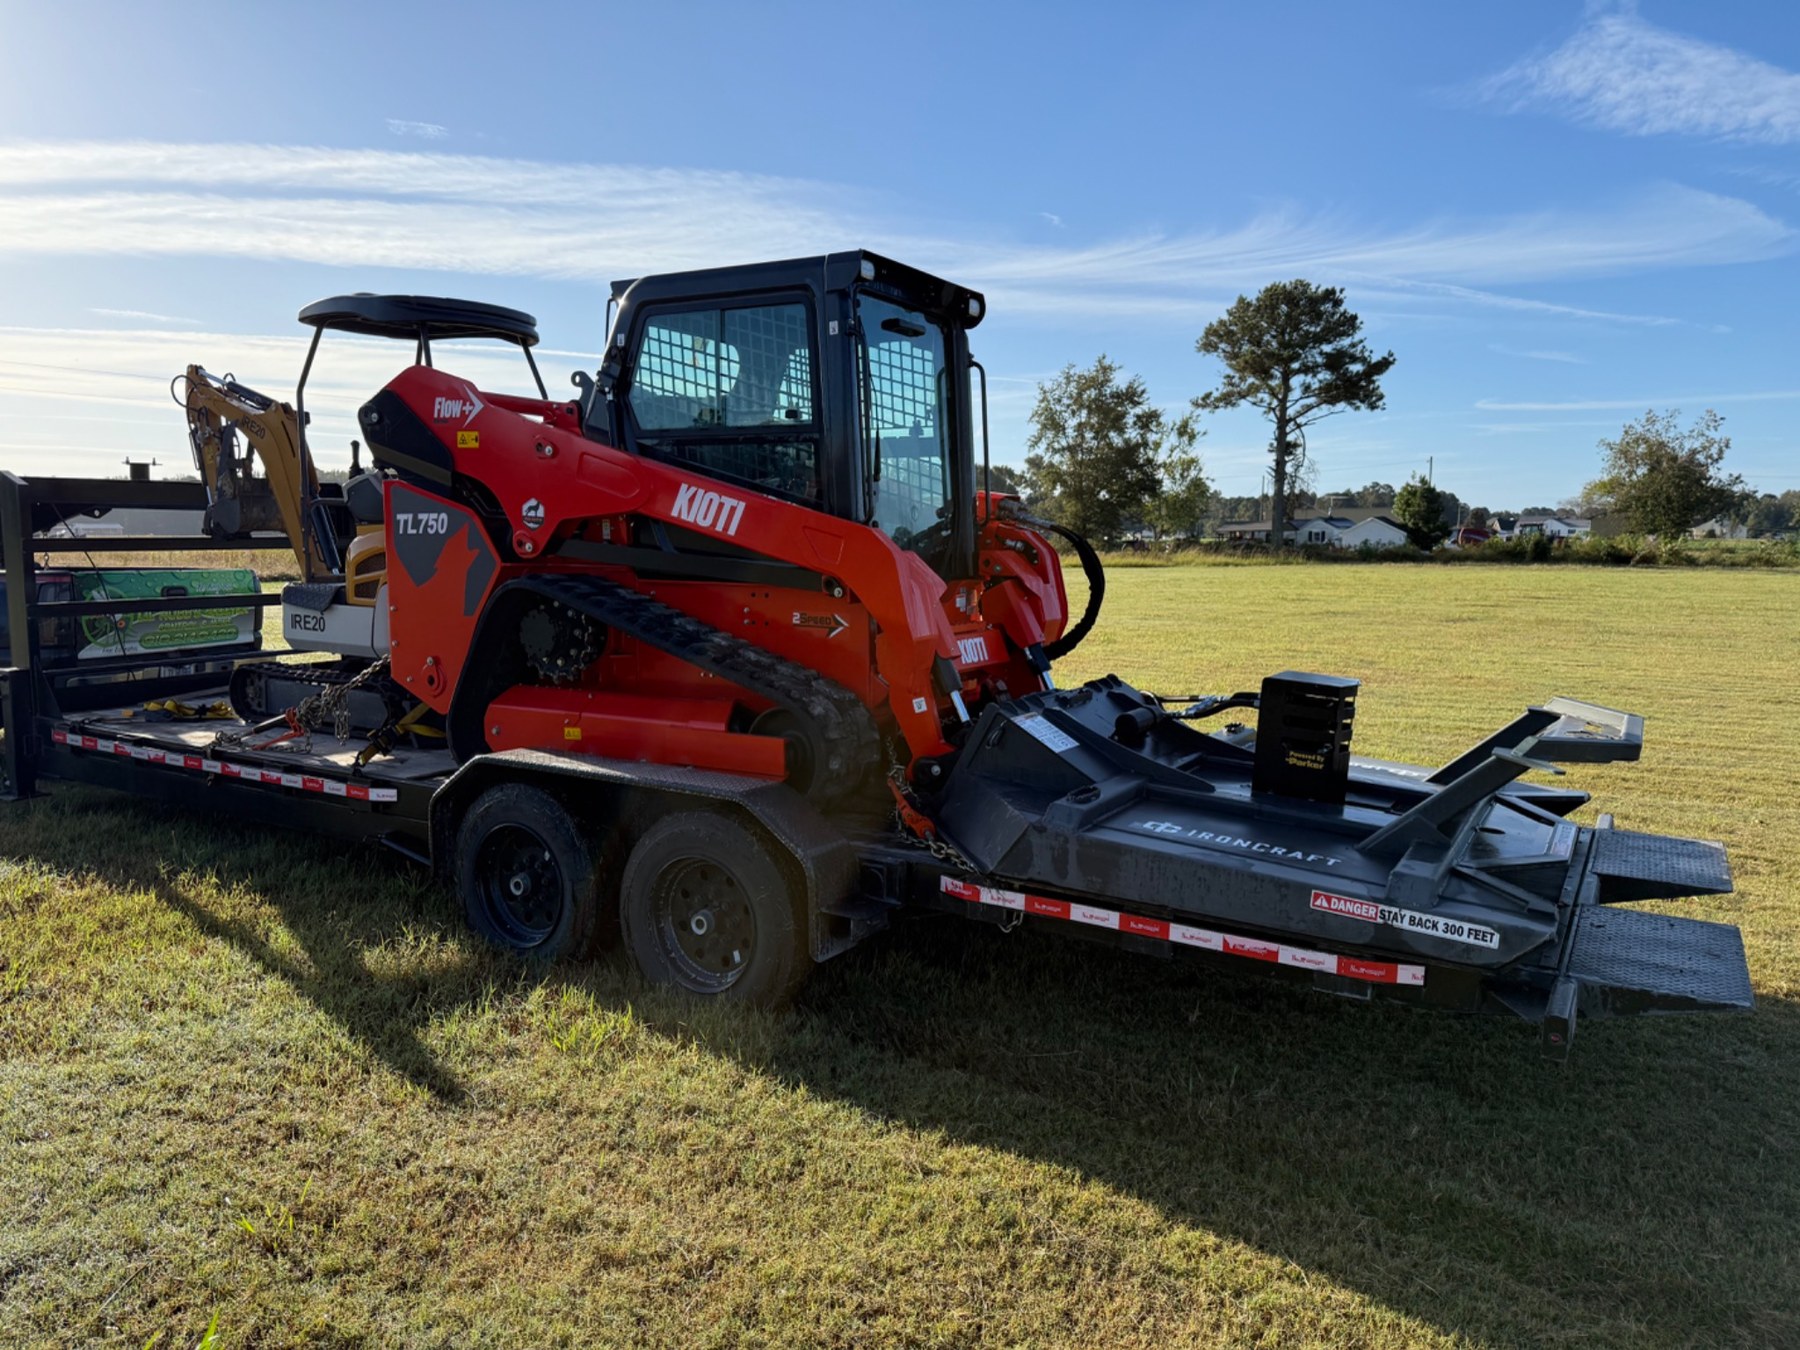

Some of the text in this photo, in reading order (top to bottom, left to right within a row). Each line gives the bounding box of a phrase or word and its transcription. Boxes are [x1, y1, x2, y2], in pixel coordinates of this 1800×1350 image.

[396, 513, 448, 535] TL750
[671, 483, 746, 536] KIOTI
[291, 613, 326, 632] IRE20
[957, 636, 989, 664] KIOTI
[1187, 829, 1342, 866] IRONCRAFT
[1330, 897, 1496, 944] DANGER STAY BACK 300 FEET
